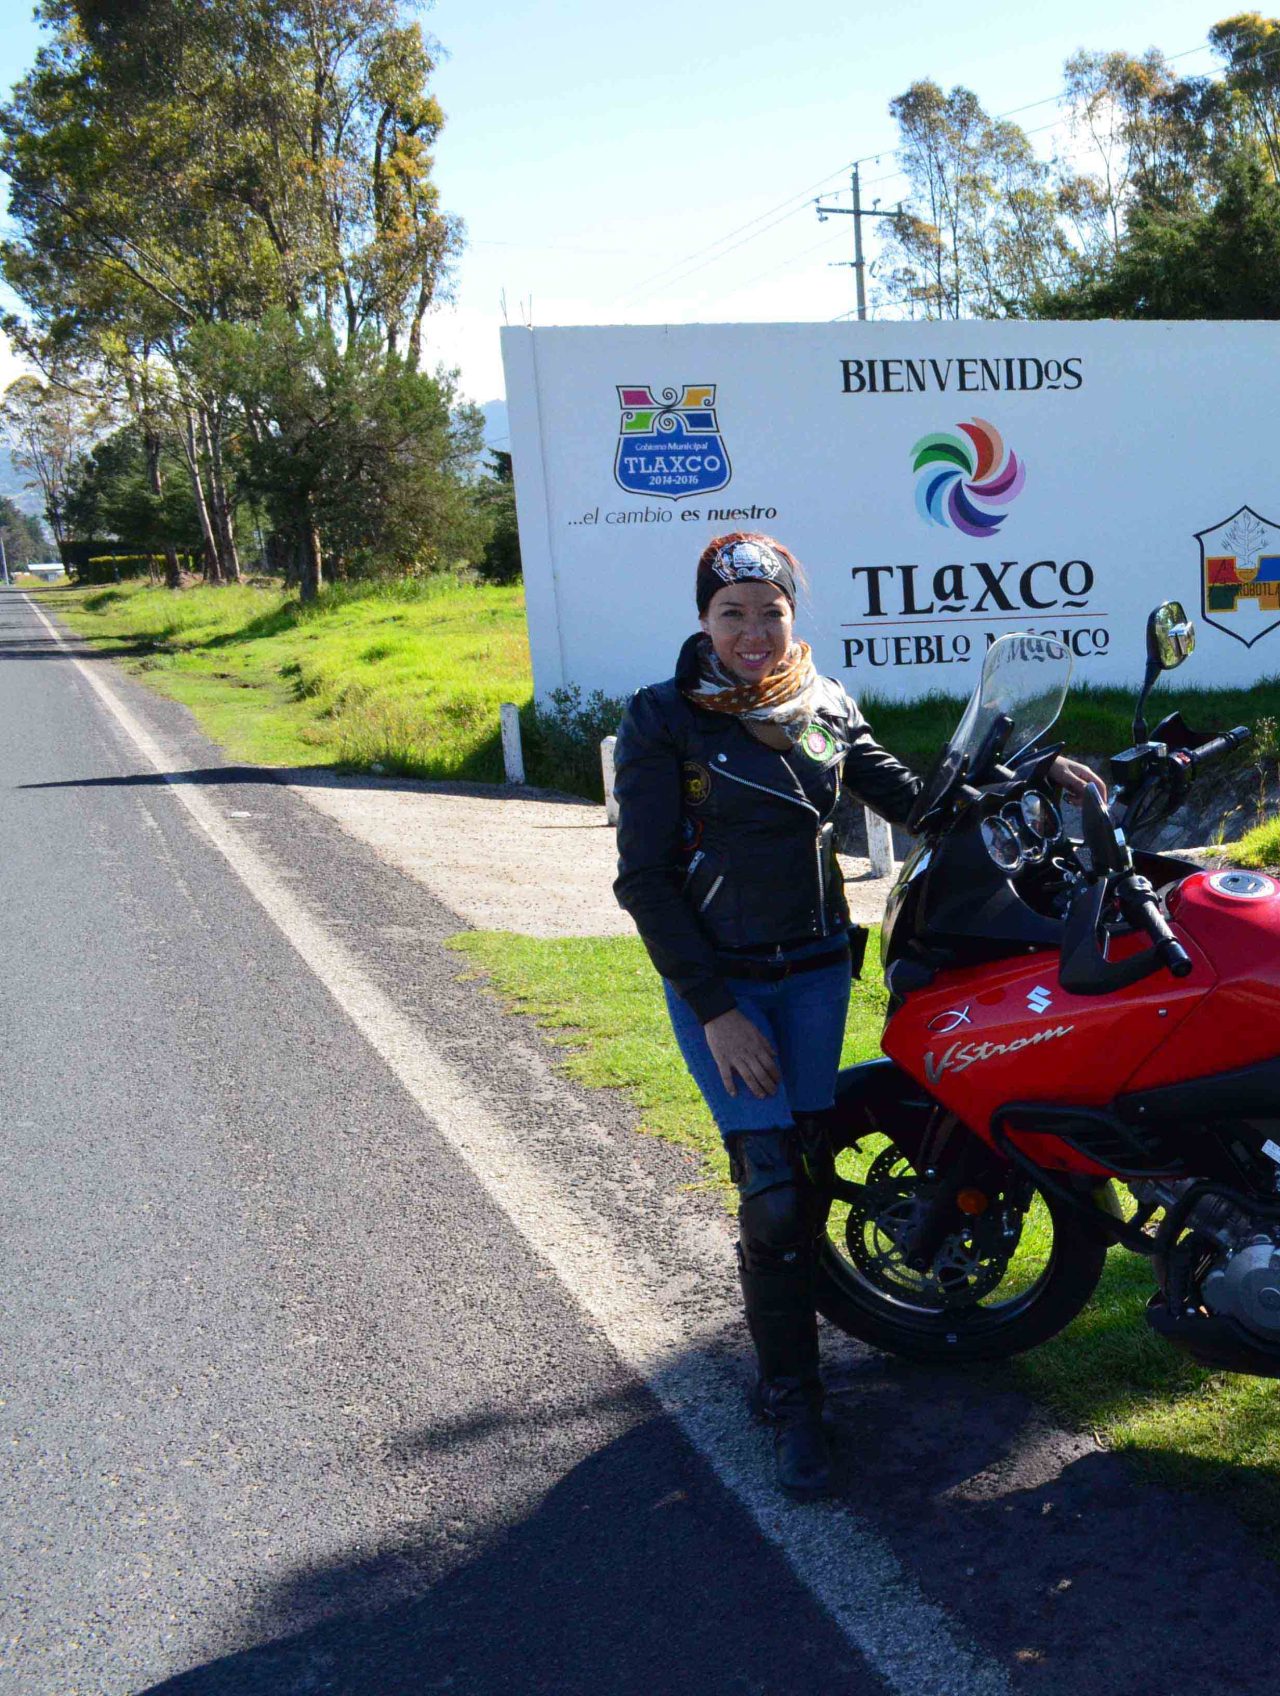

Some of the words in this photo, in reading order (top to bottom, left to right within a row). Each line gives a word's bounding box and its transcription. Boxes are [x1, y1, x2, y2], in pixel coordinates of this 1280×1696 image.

[668, 442, 708, 451] Municipal
[624, 456, 721, 474] TLAXCO
[648, 475, 699, 486] 2014-2016
[605, 507, 673, 525] cambio
[680, 509, 701, 522] es
[707, 504, 778, 521] nuestro
